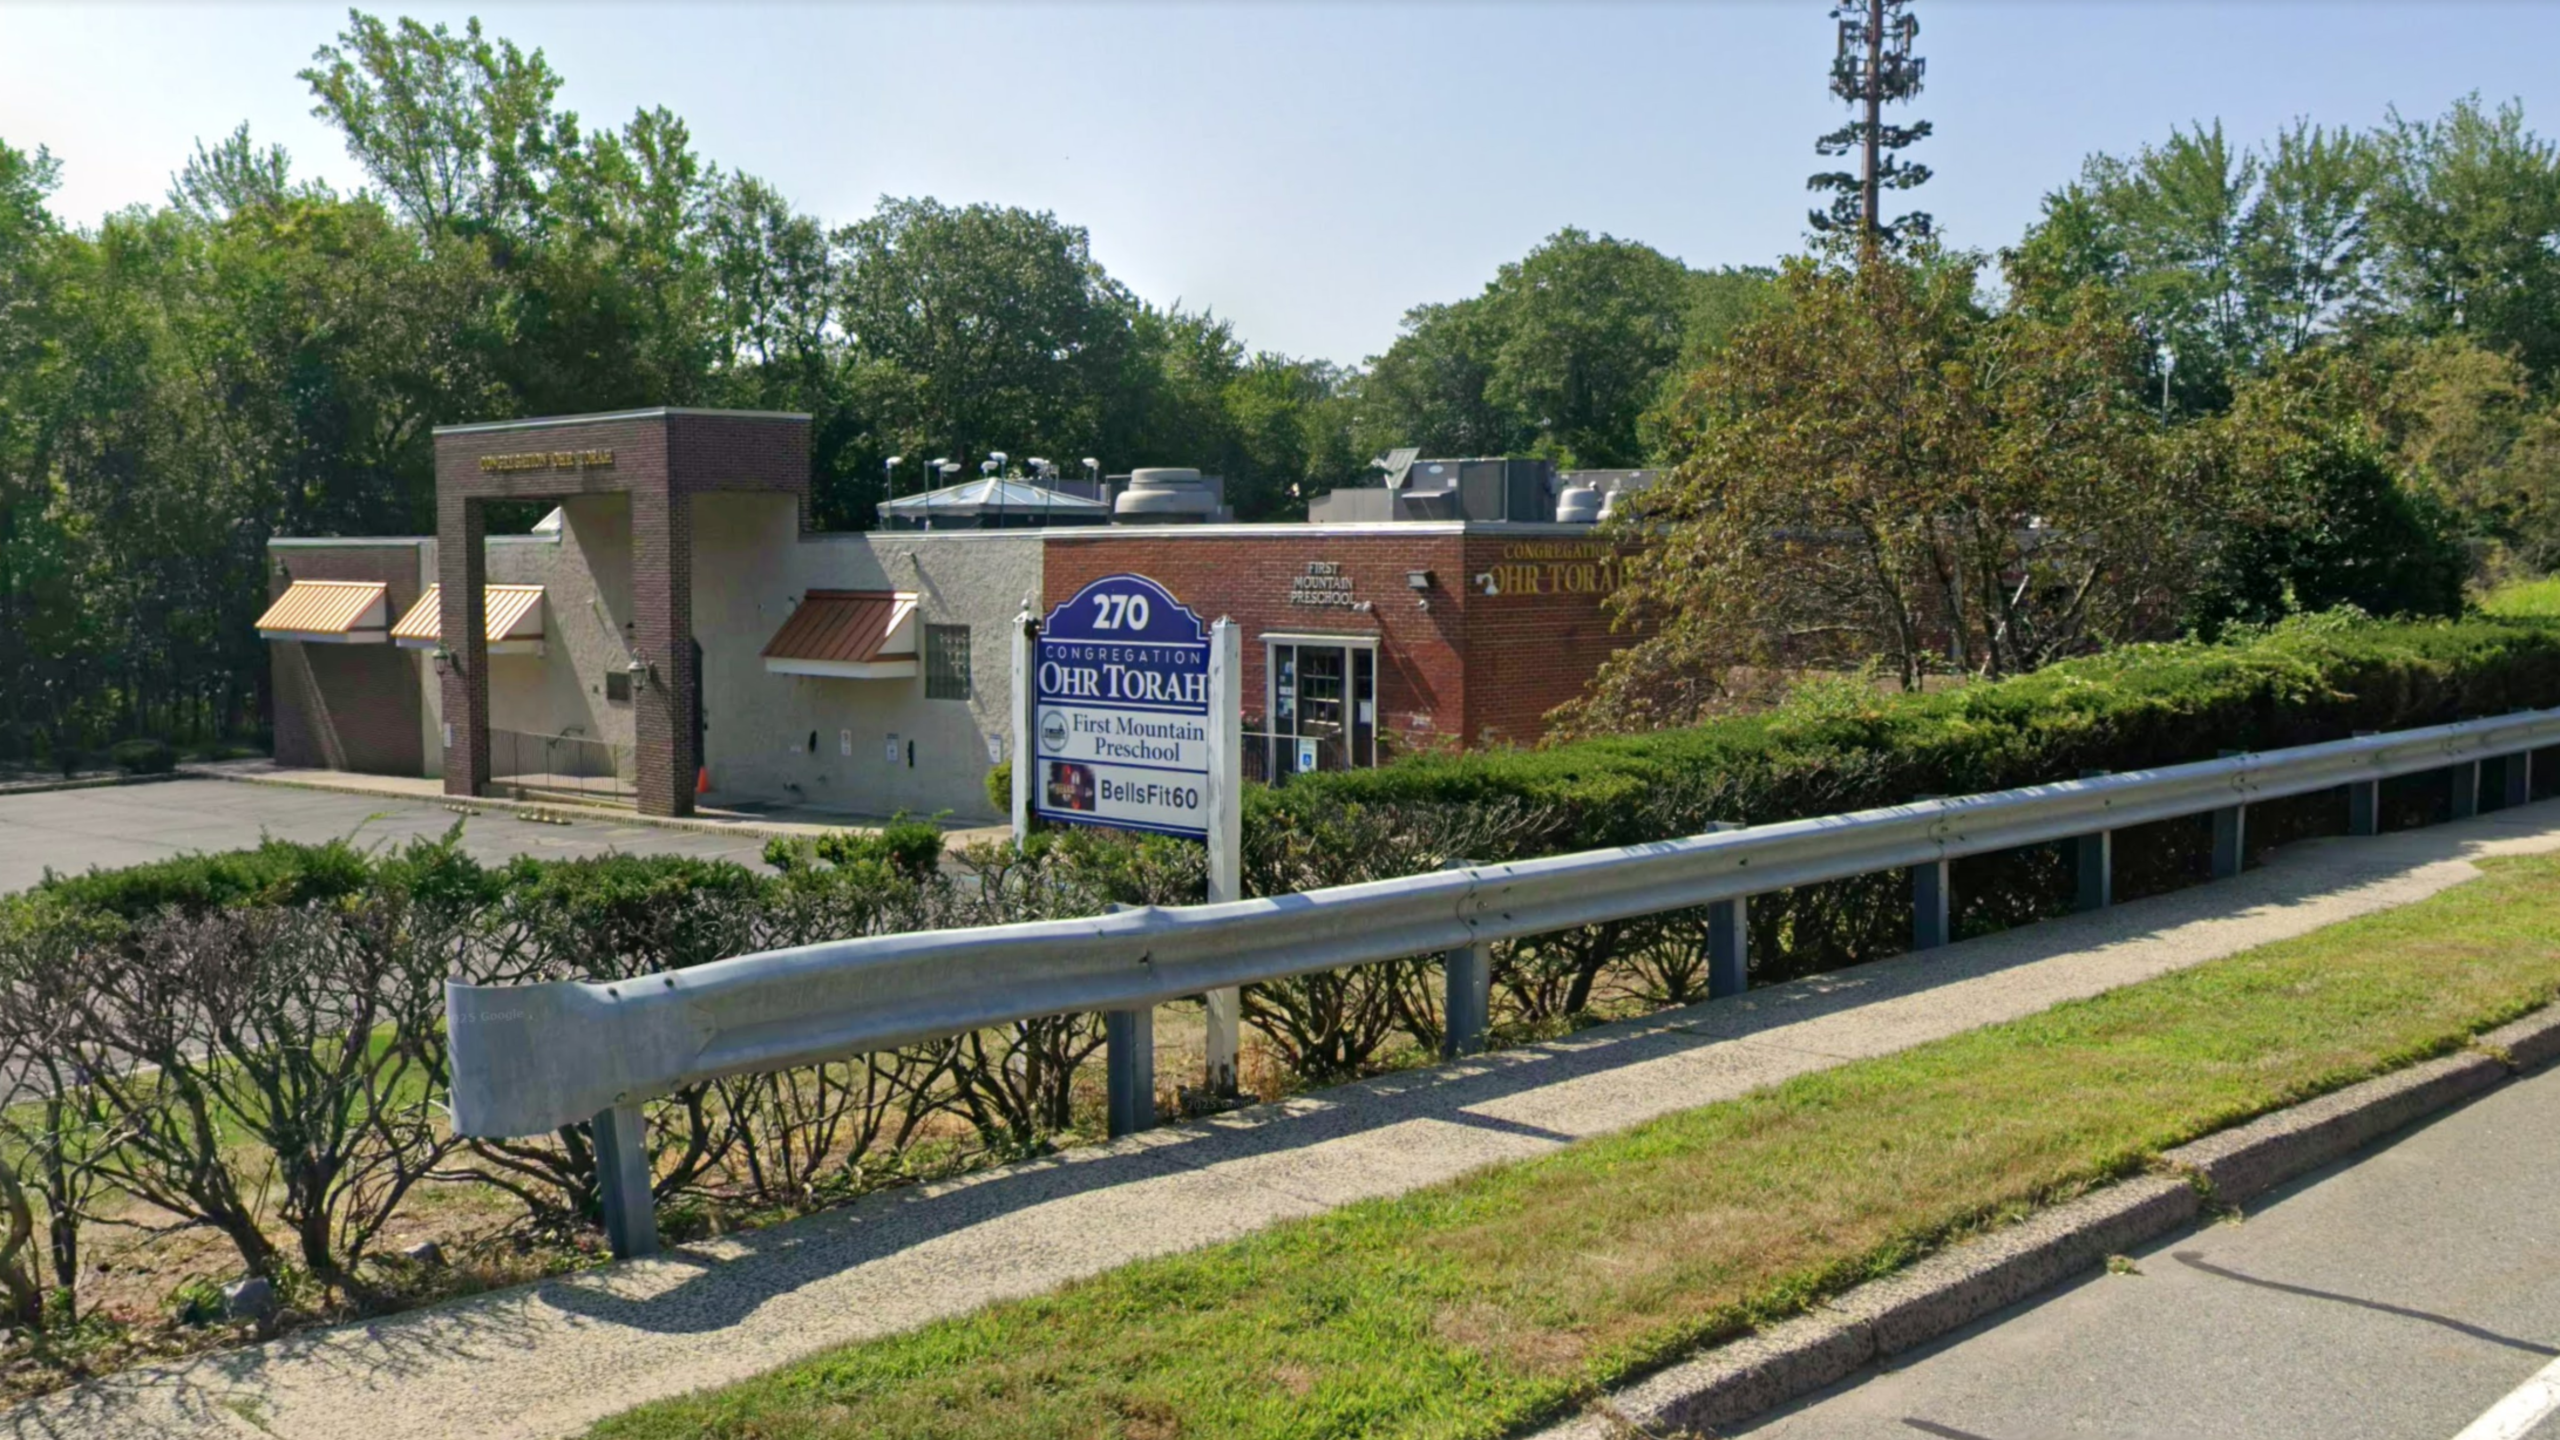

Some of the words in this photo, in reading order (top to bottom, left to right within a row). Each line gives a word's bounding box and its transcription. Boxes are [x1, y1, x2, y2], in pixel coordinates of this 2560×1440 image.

[1309, 561, 1340, 574] FIRST
[1294, 576, 1354, 589] MOUNTAIN
[1291, 591, 1356, 605] PRESCHOOL
[1092, 594, 1149, 631] 270
[1045, 645, 1201, 664] CONGREGATION
[1039, 661, 1100, 697] OHR
[1103, 664, 1208, 702] TORAH
[1073, 713, 1111, 734] First
[1116, 716, 1204, 741] Mountain
[1095, 737, 1180, 762] Preschool
[1101, 780, 1199, 810] BellsFit60
